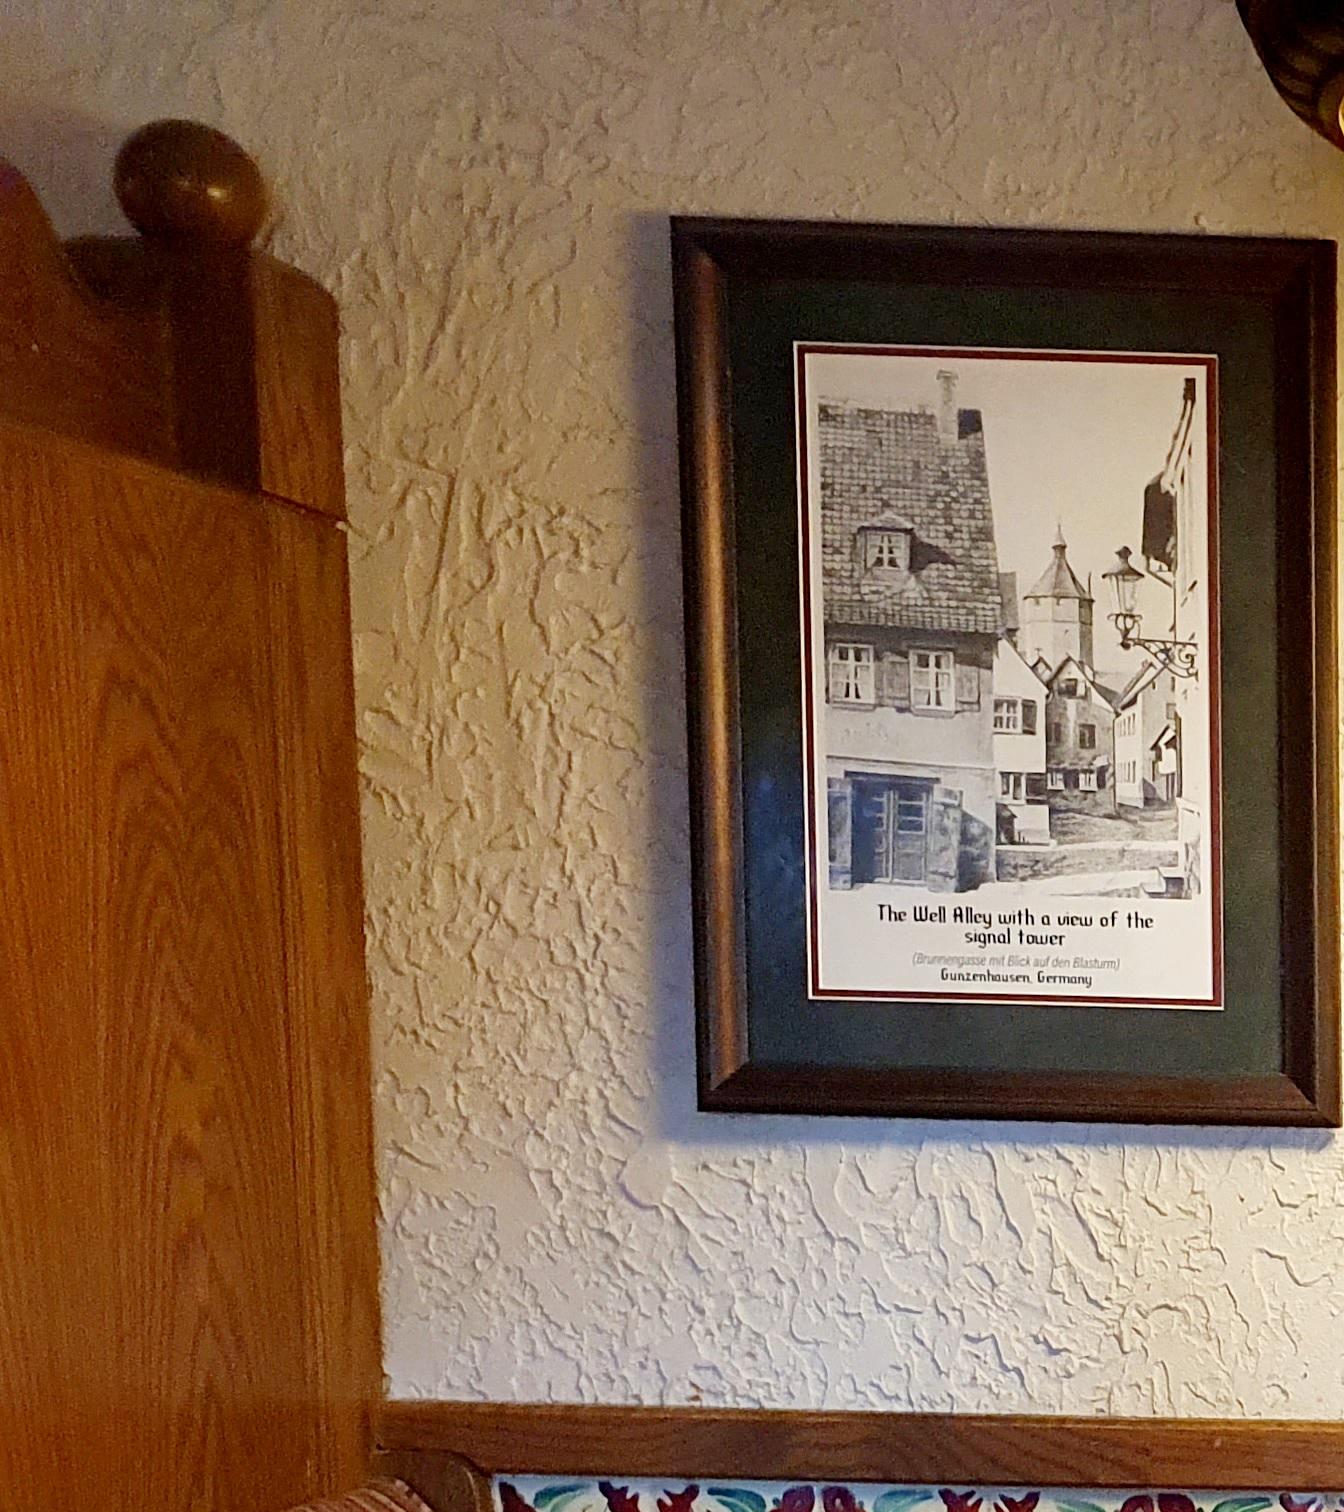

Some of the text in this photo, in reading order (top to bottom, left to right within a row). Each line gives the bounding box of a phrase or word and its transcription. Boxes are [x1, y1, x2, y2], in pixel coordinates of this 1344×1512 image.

[877, 903, 1154, 930] The Well Alley with a view of the
[964, 927, 1066, 949] signal tower
[988, 954, 1005, 967] mit
[1007, 954, 1031, 968] Blick
[1033, 955, 1050, 968] auf
[1051, 956, 1071, 969] den
[1037, 970, 1092, 989] Germany
